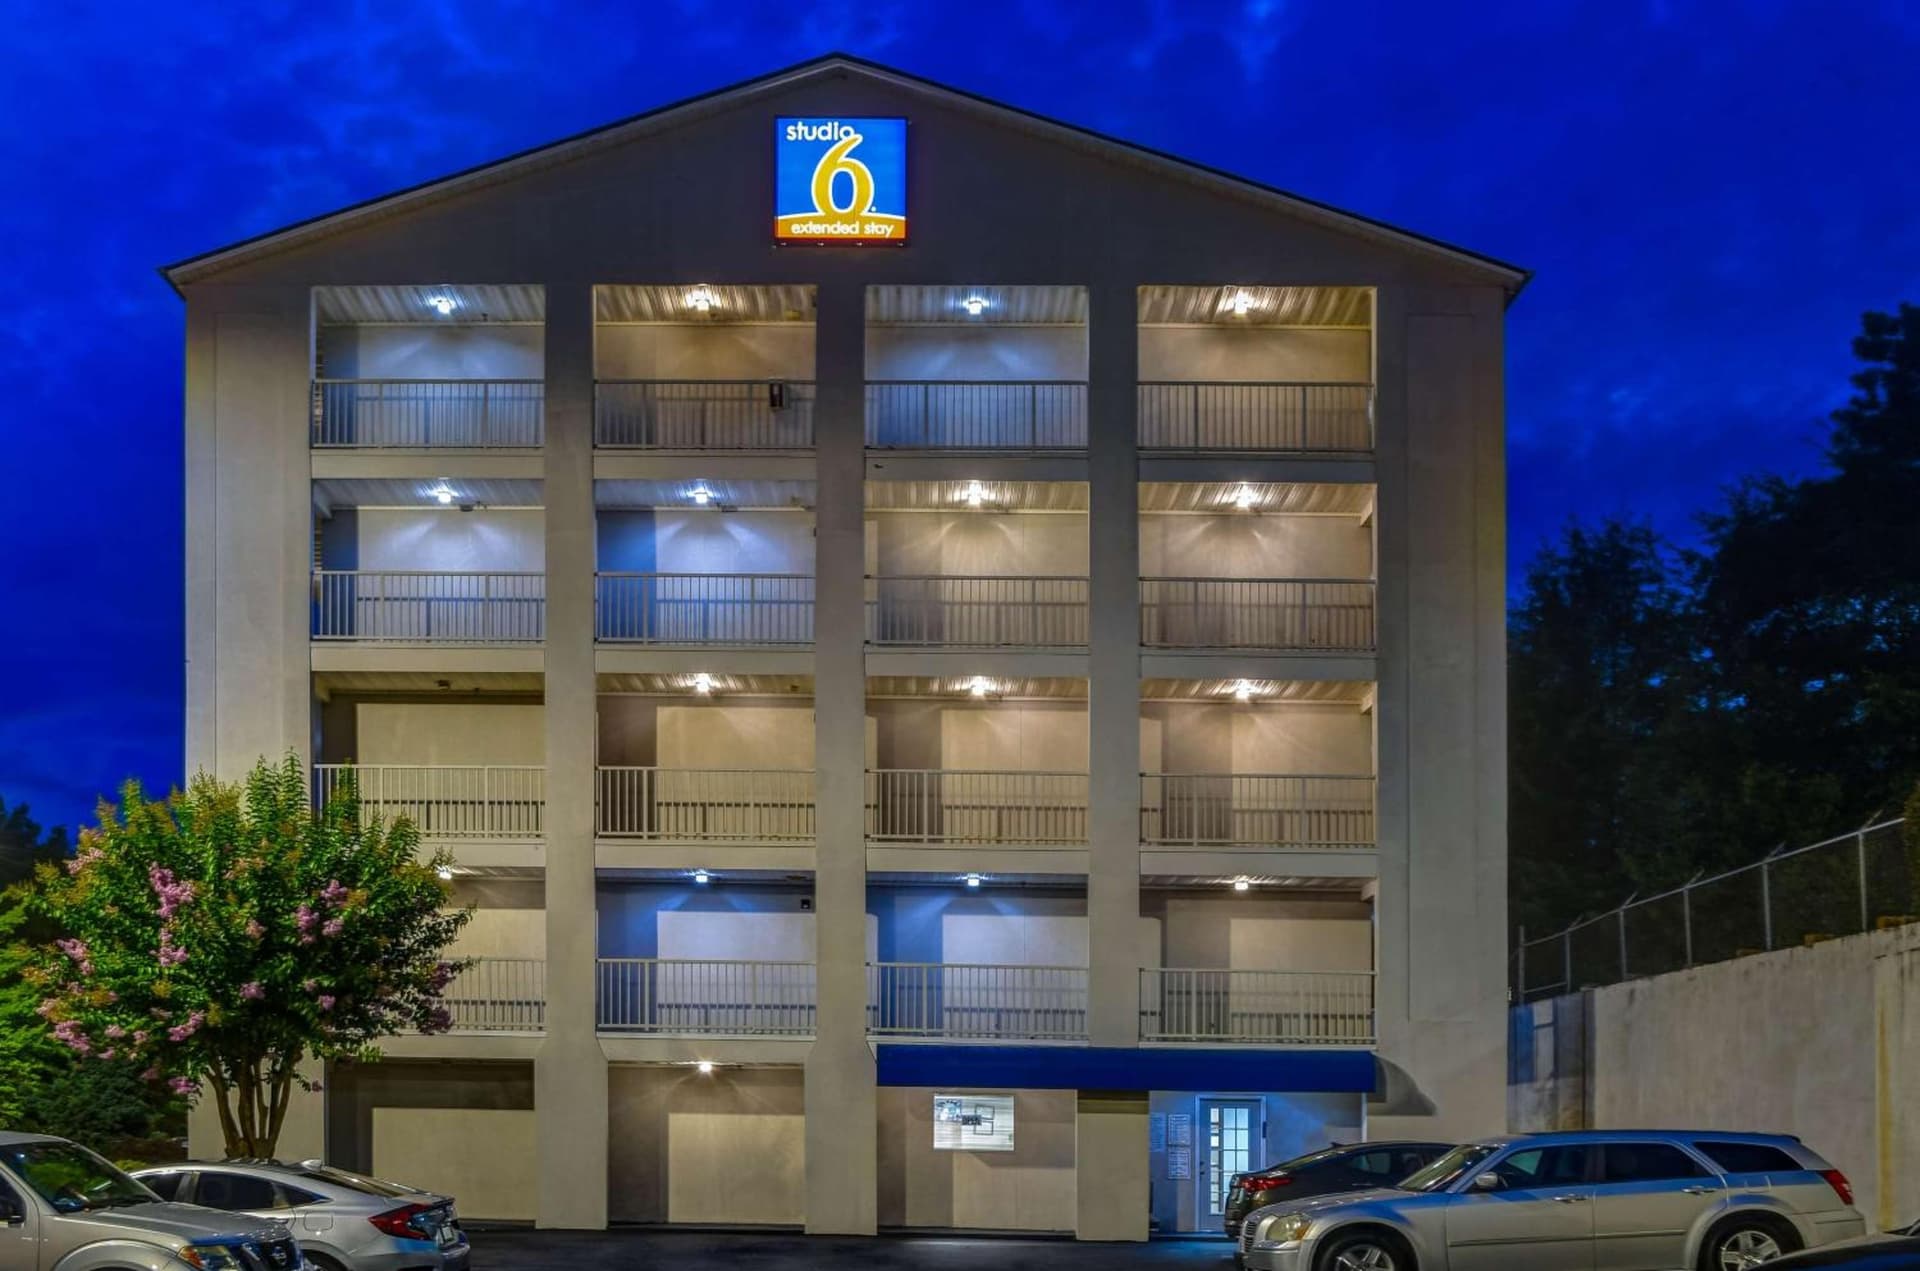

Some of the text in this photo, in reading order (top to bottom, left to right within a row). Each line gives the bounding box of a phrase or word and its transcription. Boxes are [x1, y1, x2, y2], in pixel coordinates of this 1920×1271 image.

[786, 121, 855, 141] studio
[811, 133, 875, 215] 6
[791, 221, 895, 238] extended stay
